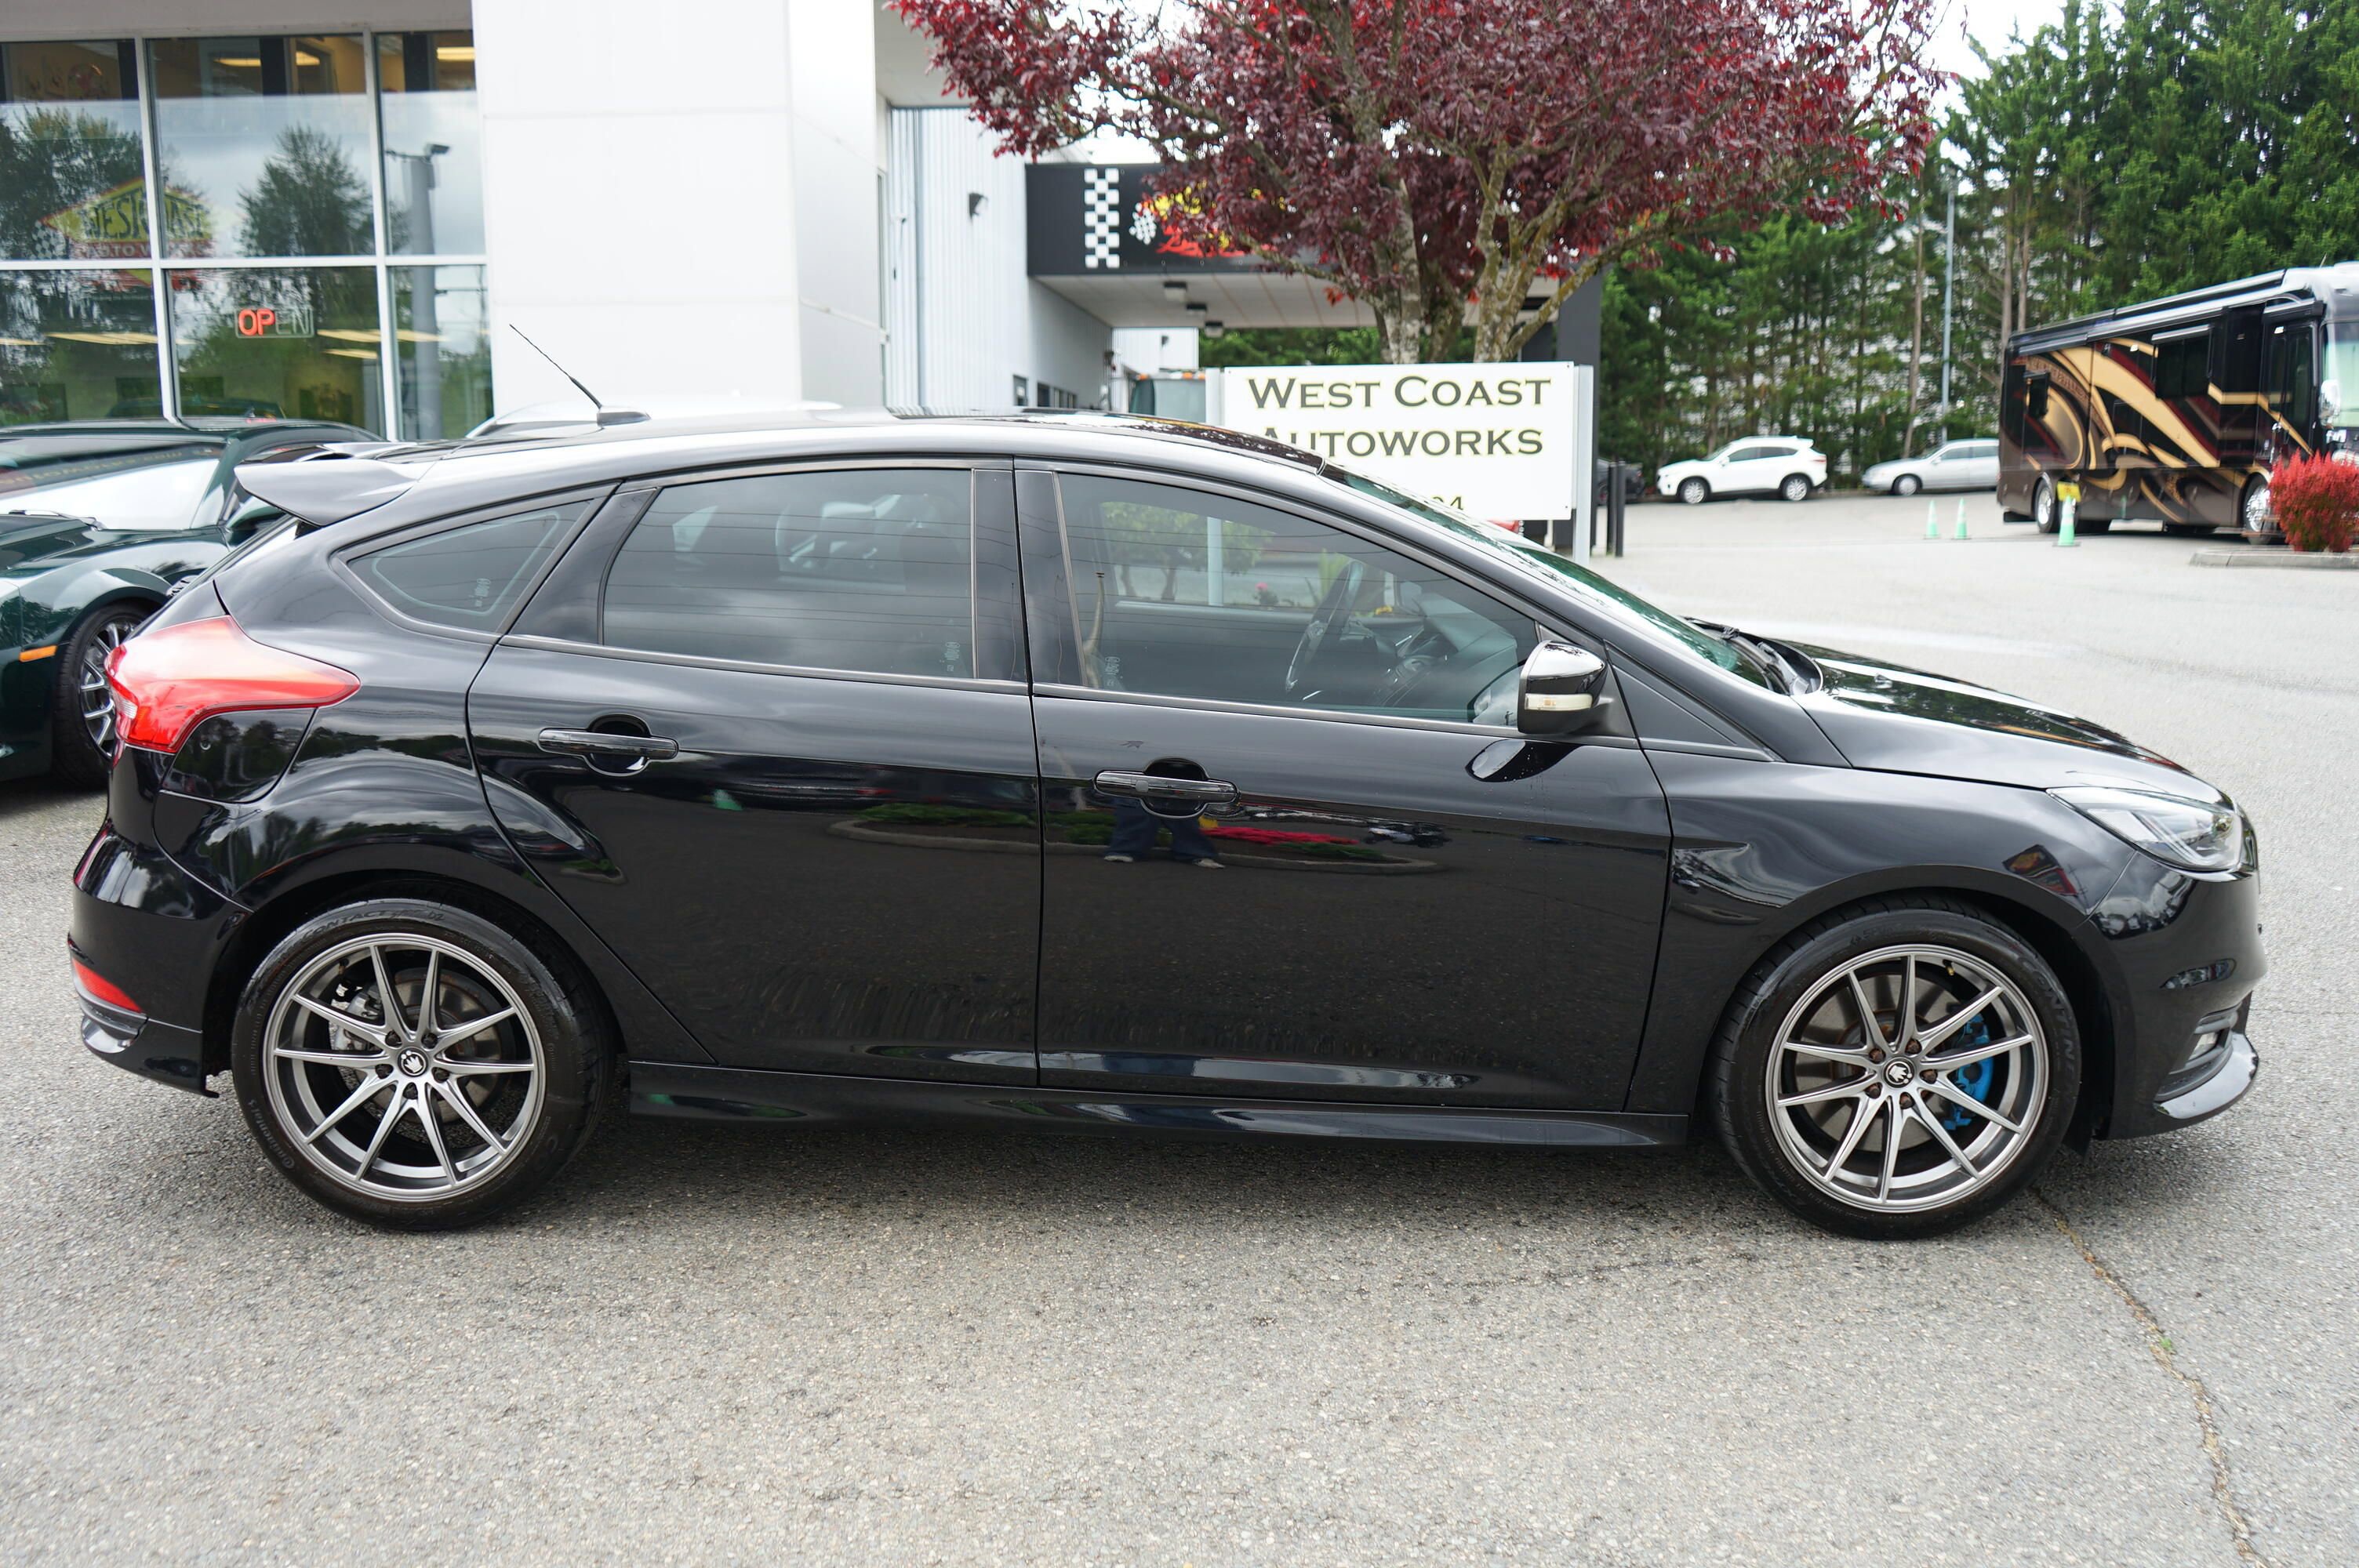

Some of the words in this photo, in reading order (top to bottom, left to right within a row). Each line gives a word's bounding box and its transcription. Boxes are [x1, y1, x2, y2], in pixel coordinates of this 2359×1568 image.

[238, 307, 309, 336] OPEN
[1248, 378, 1380, 408] WEST
[1394, 376, 1551, 407] COAST
